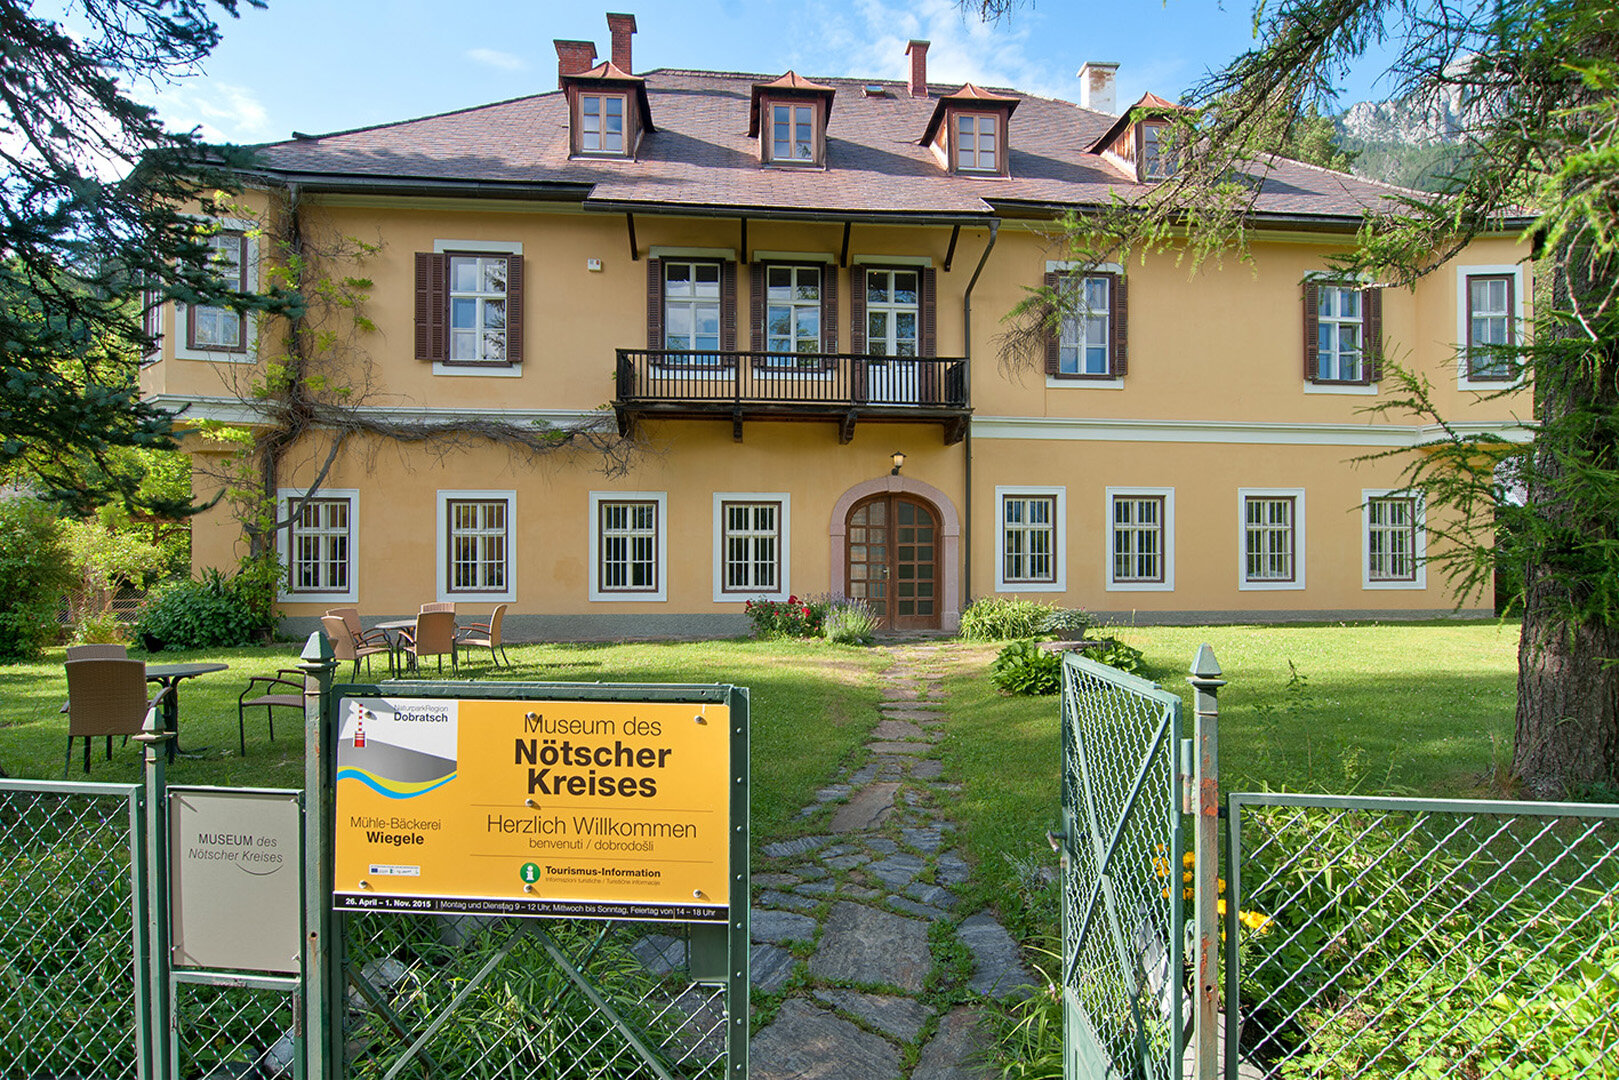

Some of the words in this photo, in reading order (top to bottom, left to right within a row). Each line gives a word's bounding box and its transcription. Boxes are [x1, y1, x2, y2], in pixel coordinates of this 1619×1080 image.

[393, 704, 449, 713] NaturparkRegion
[393, 711, 448, 723] Dobratsch
[524, 714, 616, 735] Museum
[623, 716, 662, 736] des
[514, 738, 672, 768] Nötscher
[527, 768, 657, 798] Kreises
[350, 816, 442, 831] Mühle-Bäckerei
[487, 814, 566, 834] Herzlich
[573, 816, 697, 838] Willkommen
[198, 833, 253, 846] MUSEUM
[256, 836, 278, 848] des
[366, 831, 425, 846] Wiegele
[529, 838, 583, 850] benvenuti
[594, 840, 654, 852] dobrodošli
[188, 848, 239, 861] Nötscher
[242, 850, 283, 863] Kreises
[545, 865, 661, 878] Tourismus-Information
[345, 897, 358, 906] 26.
[359, 898, 378, 908] April
[385, 899, 393, 907] 1.
[393, 899, 411, 908] Nov.
[412, 900, 432, 909] 2015
[440, 900, 466, 910] Montag
[468, 902, 482, 910] und
[482, 901, 514, 912] Dienstag
[515, 902, 521, 911] 9
[527, 903, 537, 912] 12
[585, 905, 596, 914] bis
[630, 906, 659, 916] Feiertag
[676, 908, 685, 916] 14
[692, 908, 701, 917] 18
[702, 909, 716, 917] Uhr
